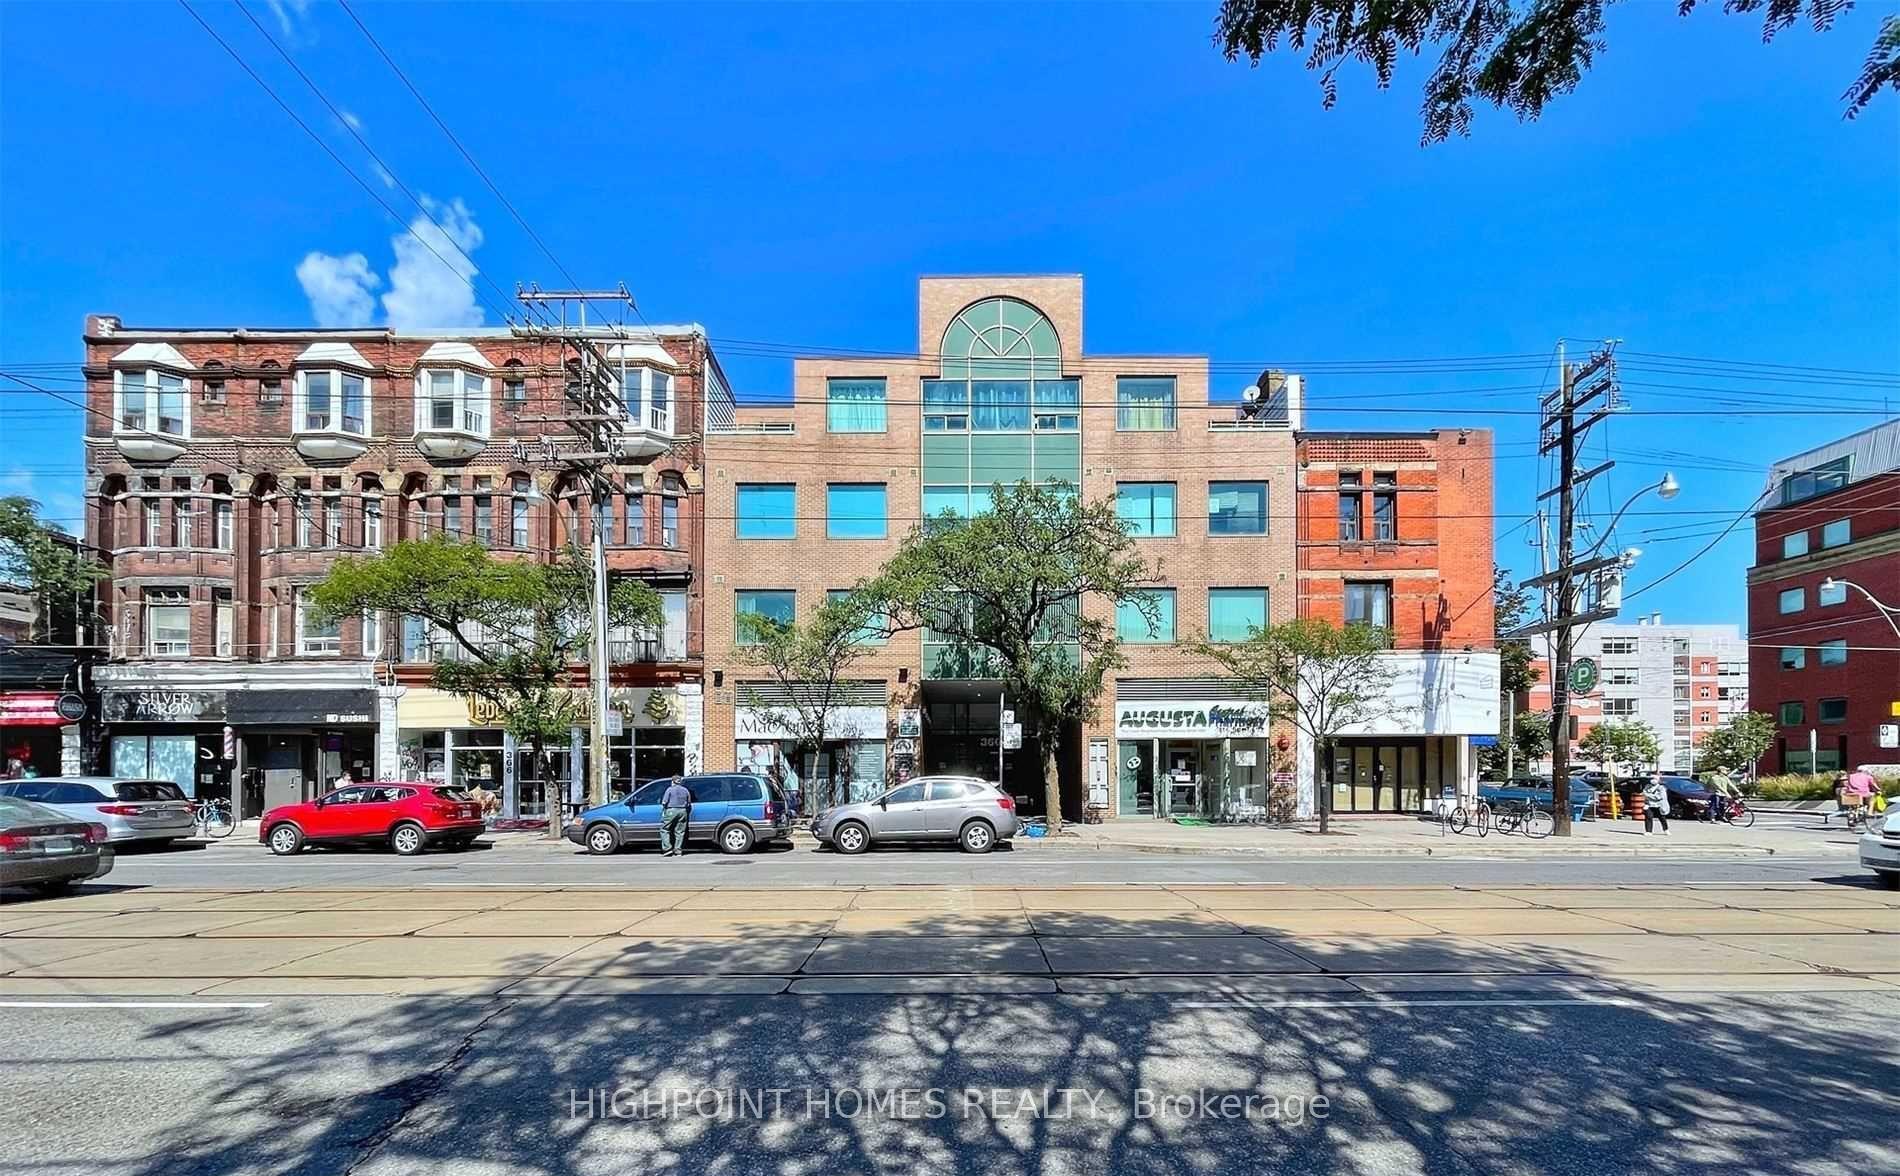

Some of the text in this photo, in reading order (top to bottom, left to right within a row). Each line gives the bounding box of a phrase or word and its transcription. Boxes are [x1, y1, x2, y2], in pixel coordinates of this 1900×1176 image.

[1577, 667, 1590, 683] P
[138, 692, 191, 705] SILVER
[340, 713, 369, 723] SUSHI
[1119, 710, 1207, 728] AUGUSTA
[504, 751, 513, 775] 366
